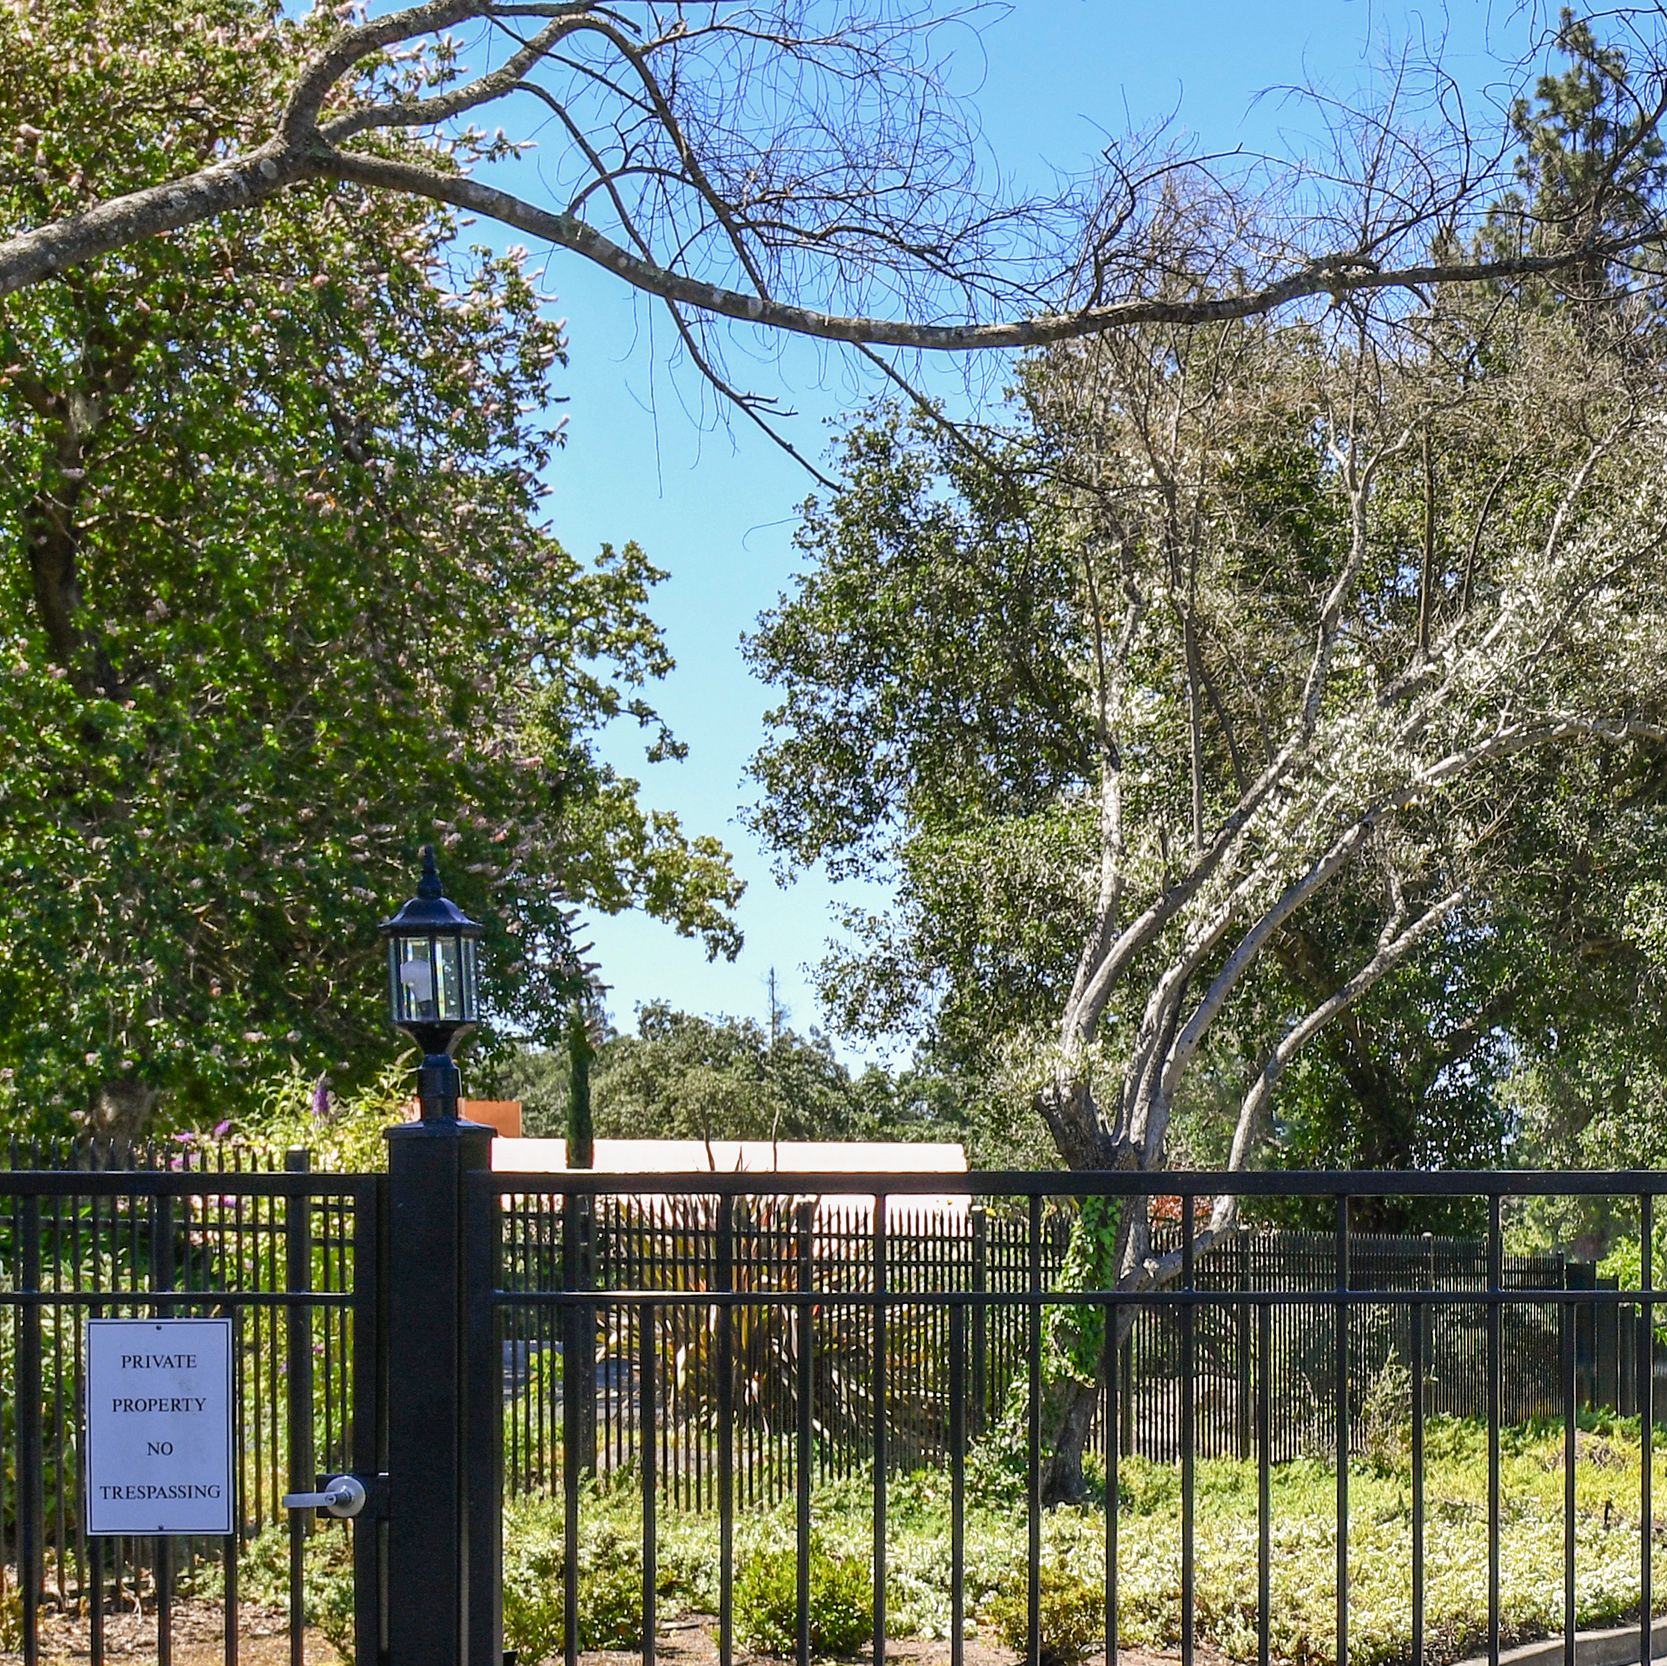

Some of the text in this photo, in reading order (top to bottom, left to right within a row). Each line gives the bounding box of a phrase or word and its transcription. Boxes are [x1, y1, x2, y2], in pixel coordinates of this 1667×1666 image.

[121, 1354, 198, 1369] PRIVATE
[112, 1397, 207, 1413] PROPERTY
[147, 1441, 174, 1456] NO
[99, 1484, 221, 1500] TRESPASSING
